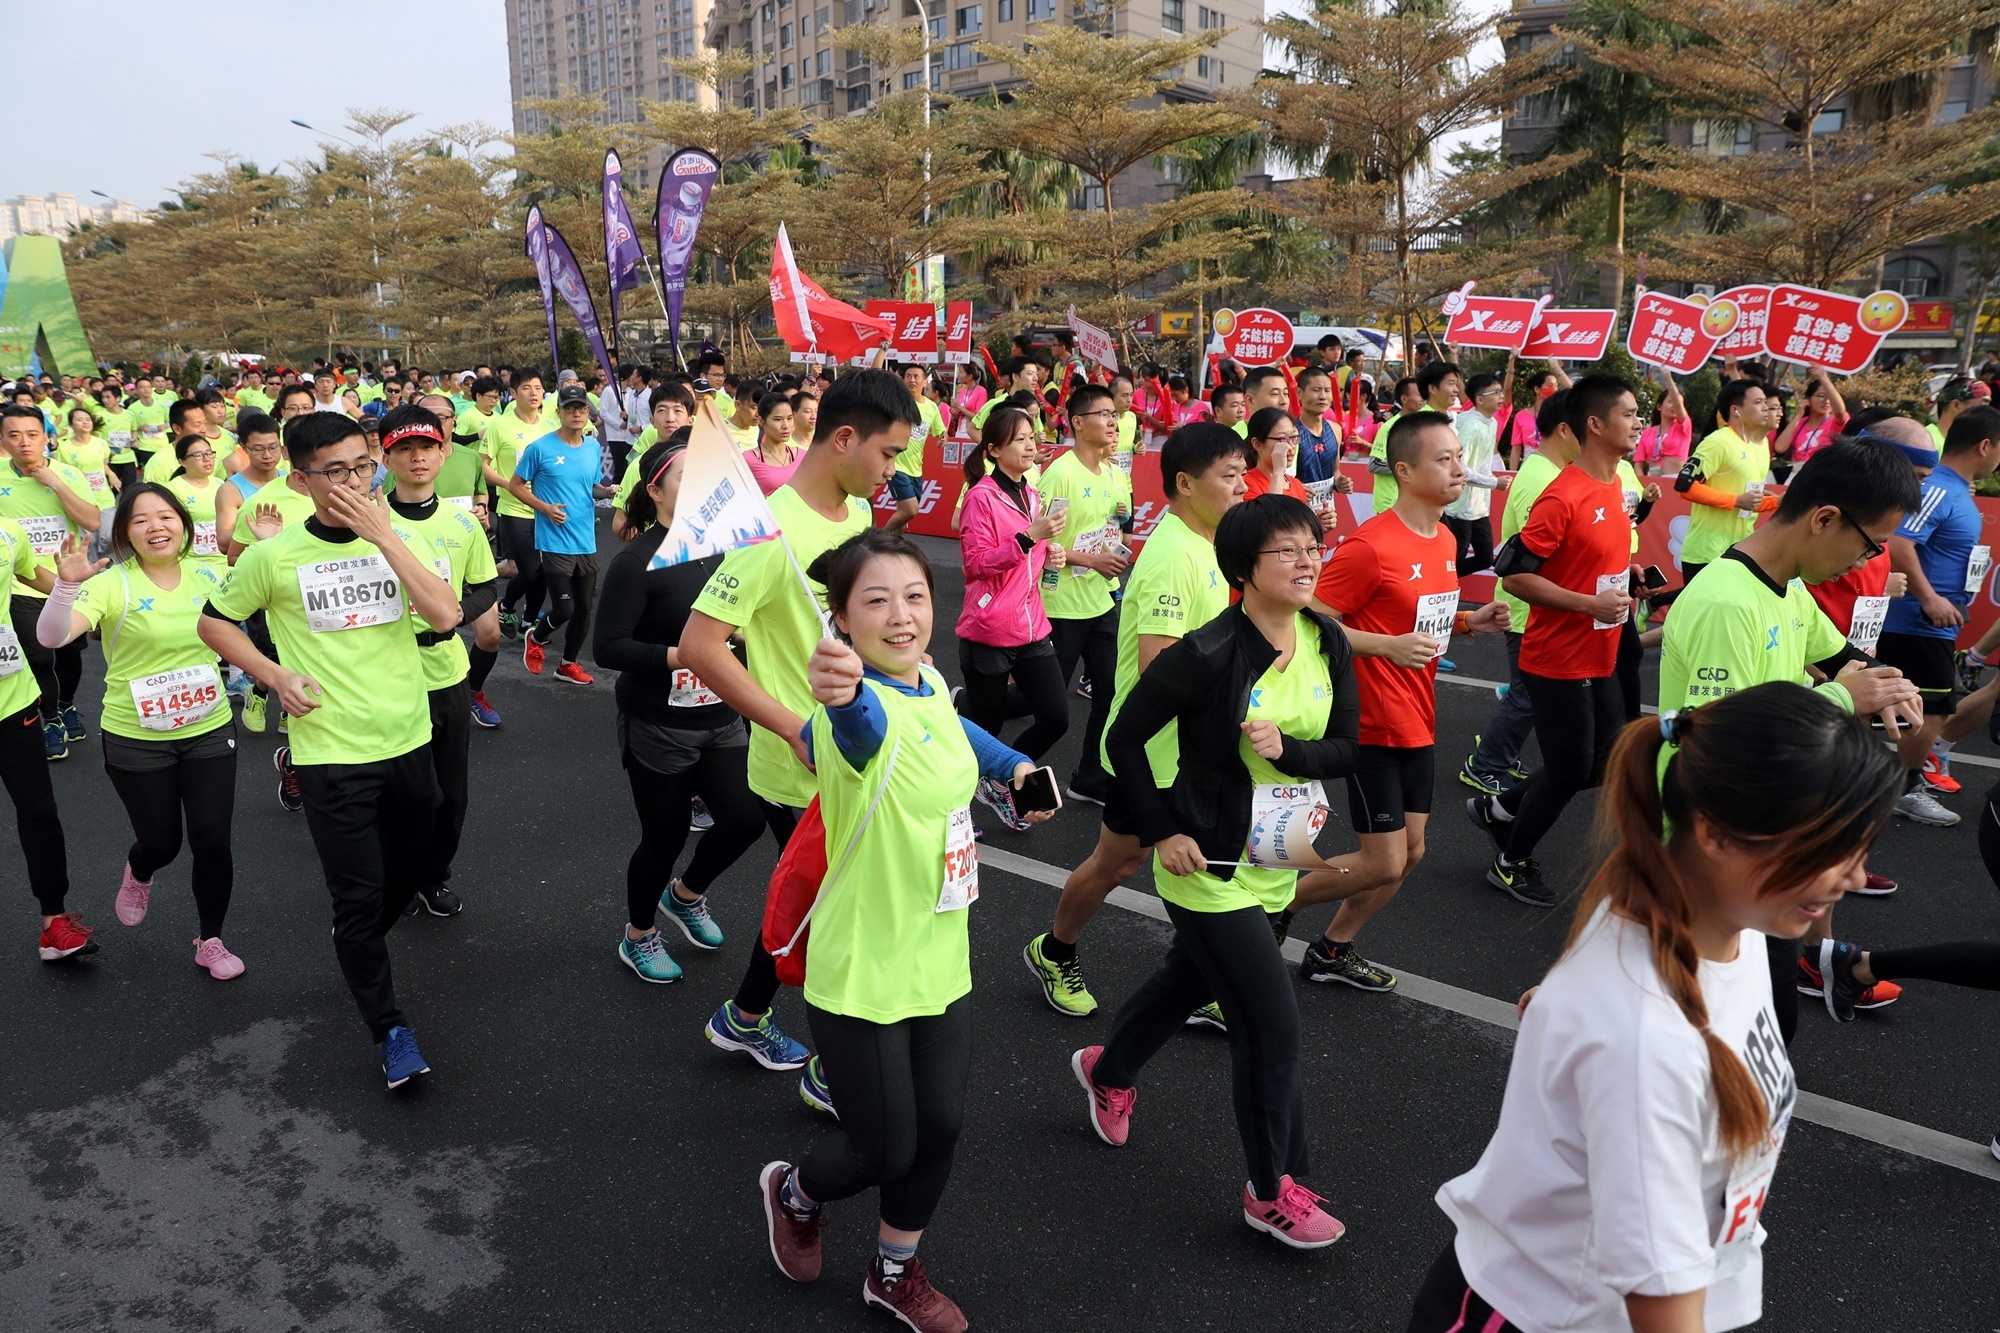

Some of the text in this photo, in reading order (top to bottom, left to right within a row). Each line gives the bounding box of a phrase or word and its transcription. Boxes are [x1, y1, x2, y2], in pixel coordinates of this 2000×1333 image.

[899, 316, 932, 339] 特
[947, 313, 969, 340] 步
[1485, 320, 1524, 334] 特步
[1651, 318, 1696, 346] 真跑者
[1793, 313, 1853, 343] 真跑者
[1240, 328, 1285, 343] 不能输在
[1561, 331, 1602, 345] 特步
[1234, 343, 1273, 359] 起跑线!
[699, 477, 736, 528] 海投集团
[315, 556, 378, 574] C&D 建发集团
[338, 575, 354, 584] 刘健
[716, 573, 739, 590] C&D
[306, 579, 397, 611] M18670
[1158, 595, 1180, 607] C&D
[1152, 608, 1184, 621] 建发集团
[146, 668, 201, 687] C&D 建发集团
[1696, 667, 1730, 683] C&D
[1689, 685, 1736, 697] 建发集团
[140, 685, 217, 718] F14545
[1272, 786, 1299, 800] C&D
